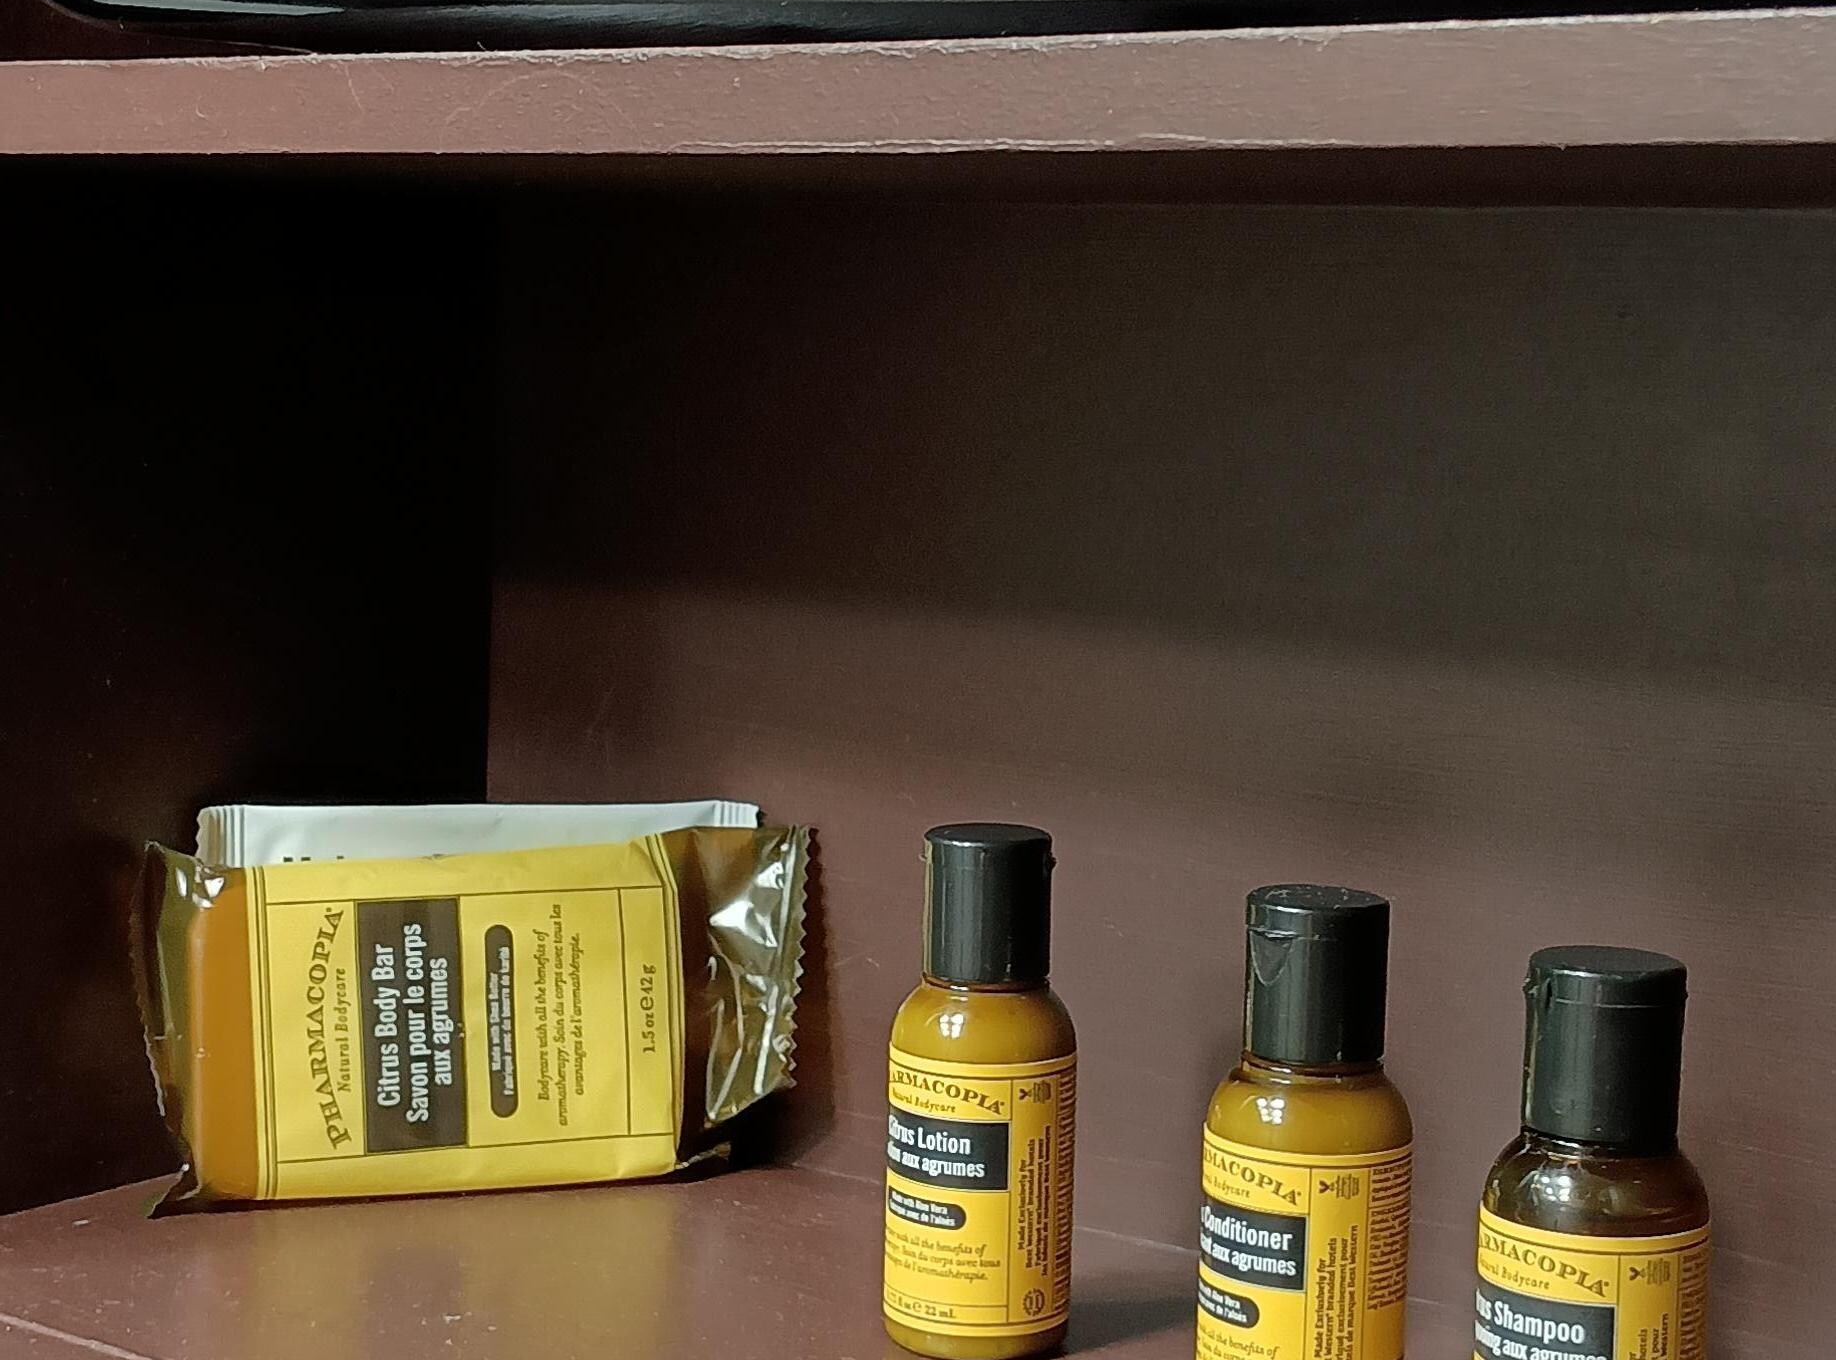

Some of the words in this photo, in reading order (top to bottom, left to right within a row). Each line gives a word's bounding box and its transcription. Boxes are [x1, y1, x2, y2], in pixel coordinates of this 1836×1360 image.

[549, 904, 562, 920] les
[532, 929, 549, 942] of
[550, 921, 563, 944] tous
[371, 943, 396, 981] Bar
[404, 923, 428, 981] corps
[532, 944, 551, 986] benefits
[552, 946, 564, 970] avec
[641, 963, 657, 975] g
[402, 985, 425, 1005] le
[534, 987, 548, 1005] the
[552, 971, 567, 1000] corps
[639, 976, 654, 995] 42
[333, 968, 351, 1033] Bodycare
[374, 986, 400, 1038] Body
[429, 957, 454, 1045] agrumes
[535, 1006, 548, 1021] all
[551, 1002, 565, 1017] du
[306, 909, 353, 1150] PHARMACOPIA
[407, 1008, 432, 1058] pour
[552, 1018, 565, 1044] Soin
[570, 1024, 583, 1038] de
[645, 1012, 656, 1028] oz
[535, 1024, 549, 1048] with
[642, 1031, 656, 1053] 1.5
[336, 1040, 352, 1093] Natural
[377, 1042, 400, 1108] Citrus
[434, 1048, 453, 1087] aux
[537, 1050, 553, 1101] Bodycare
[572, 1040, 587, 1096] avantages
[406, 1060, 429, 1124] Savon
[552, 1046, 570, 1126] aromatherapy.
[917, 1126, 971, 1155] Lotion
[902, 1151, 920, 1169] aux
[921, 1157, 985, 1178] agrumes
[1204, 1205, 1293, 1251] Conditioner
[935, 1240, 973, 1256] benefits
[974, 1243, 988, 1259] of
[1231, 1249, 1297, 1277] agrumes
[1327, 1238, 1337, 1268] hotels
[1316, 1257, 1327, 1273] for
[1502, 1265, 1551, 1291] Bodycare
[1315, 1274, 1327, 1329] Exclusively
[1326, 1269, 1336, 1311] branded
[923, 1304, 937, 1317] 22
[1494, 1300, 1586, 1345] Shampoo
[1228, 1335, 1265, 1357] benefits
[1266, 1345, 1281, 1360] of
[1314, 1331, 1324, 1359] Made
[1324, 1313, 1334, 1357] Western
[1652, 1328, 1660, 1354] pour
[1660, 1312, 1669, 1357] Western
[1502, 1339, 1528, 1360] aux
